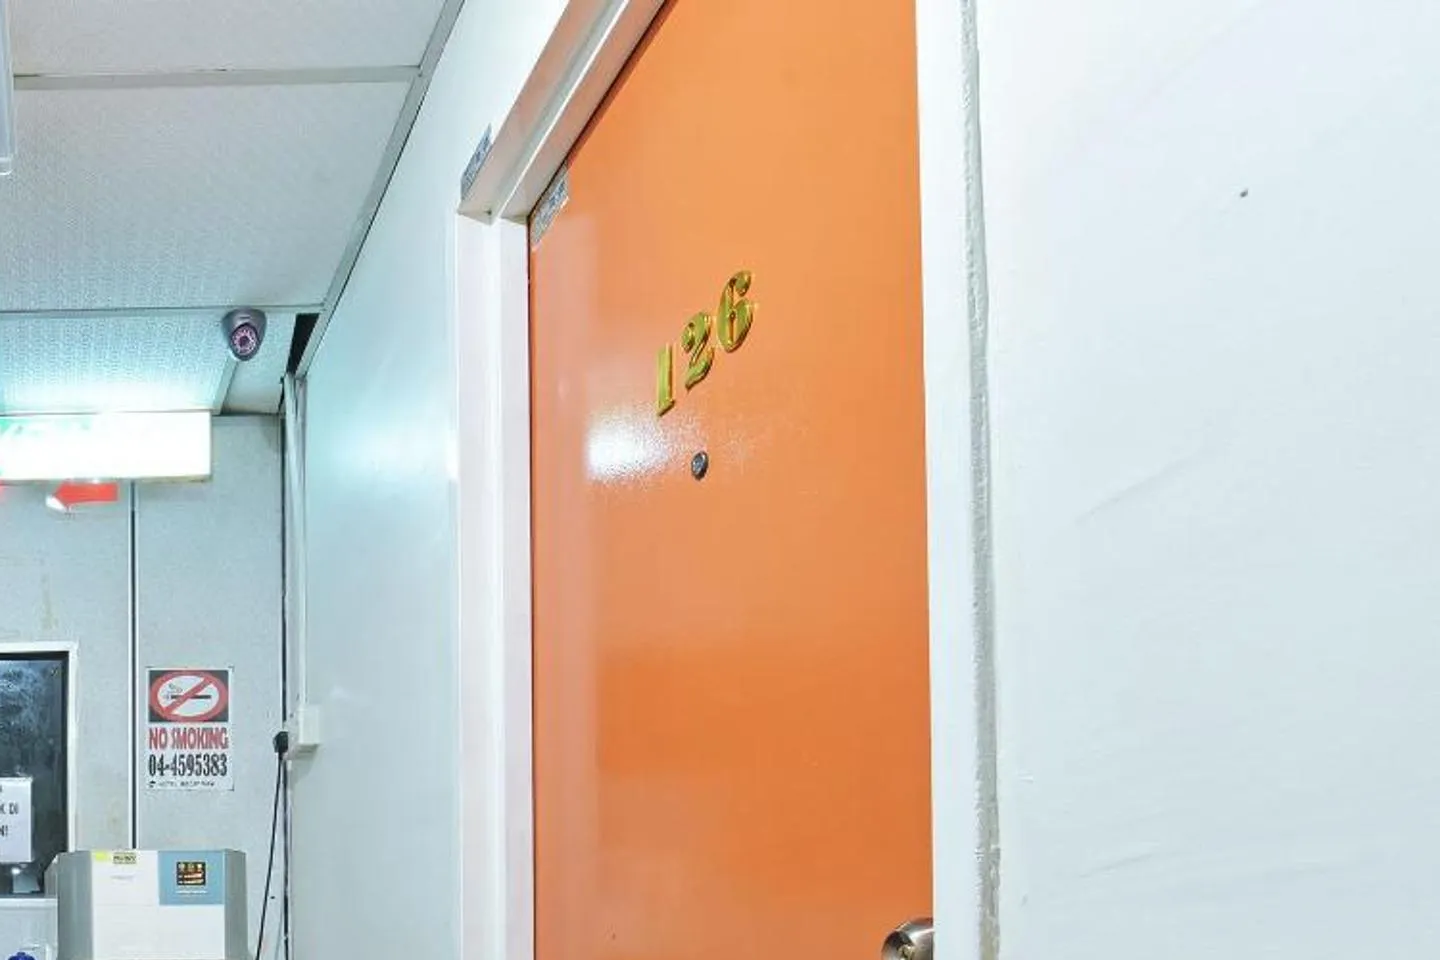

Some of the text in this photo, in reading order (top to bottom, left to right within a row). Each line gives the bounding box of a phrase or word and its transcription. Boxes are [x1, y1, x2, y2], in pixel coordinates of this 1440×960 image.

[657, 270, 753, 416] 126
[149, 727, 229, 749] NO SMOKING
[9, 803, 19, 815] DI
